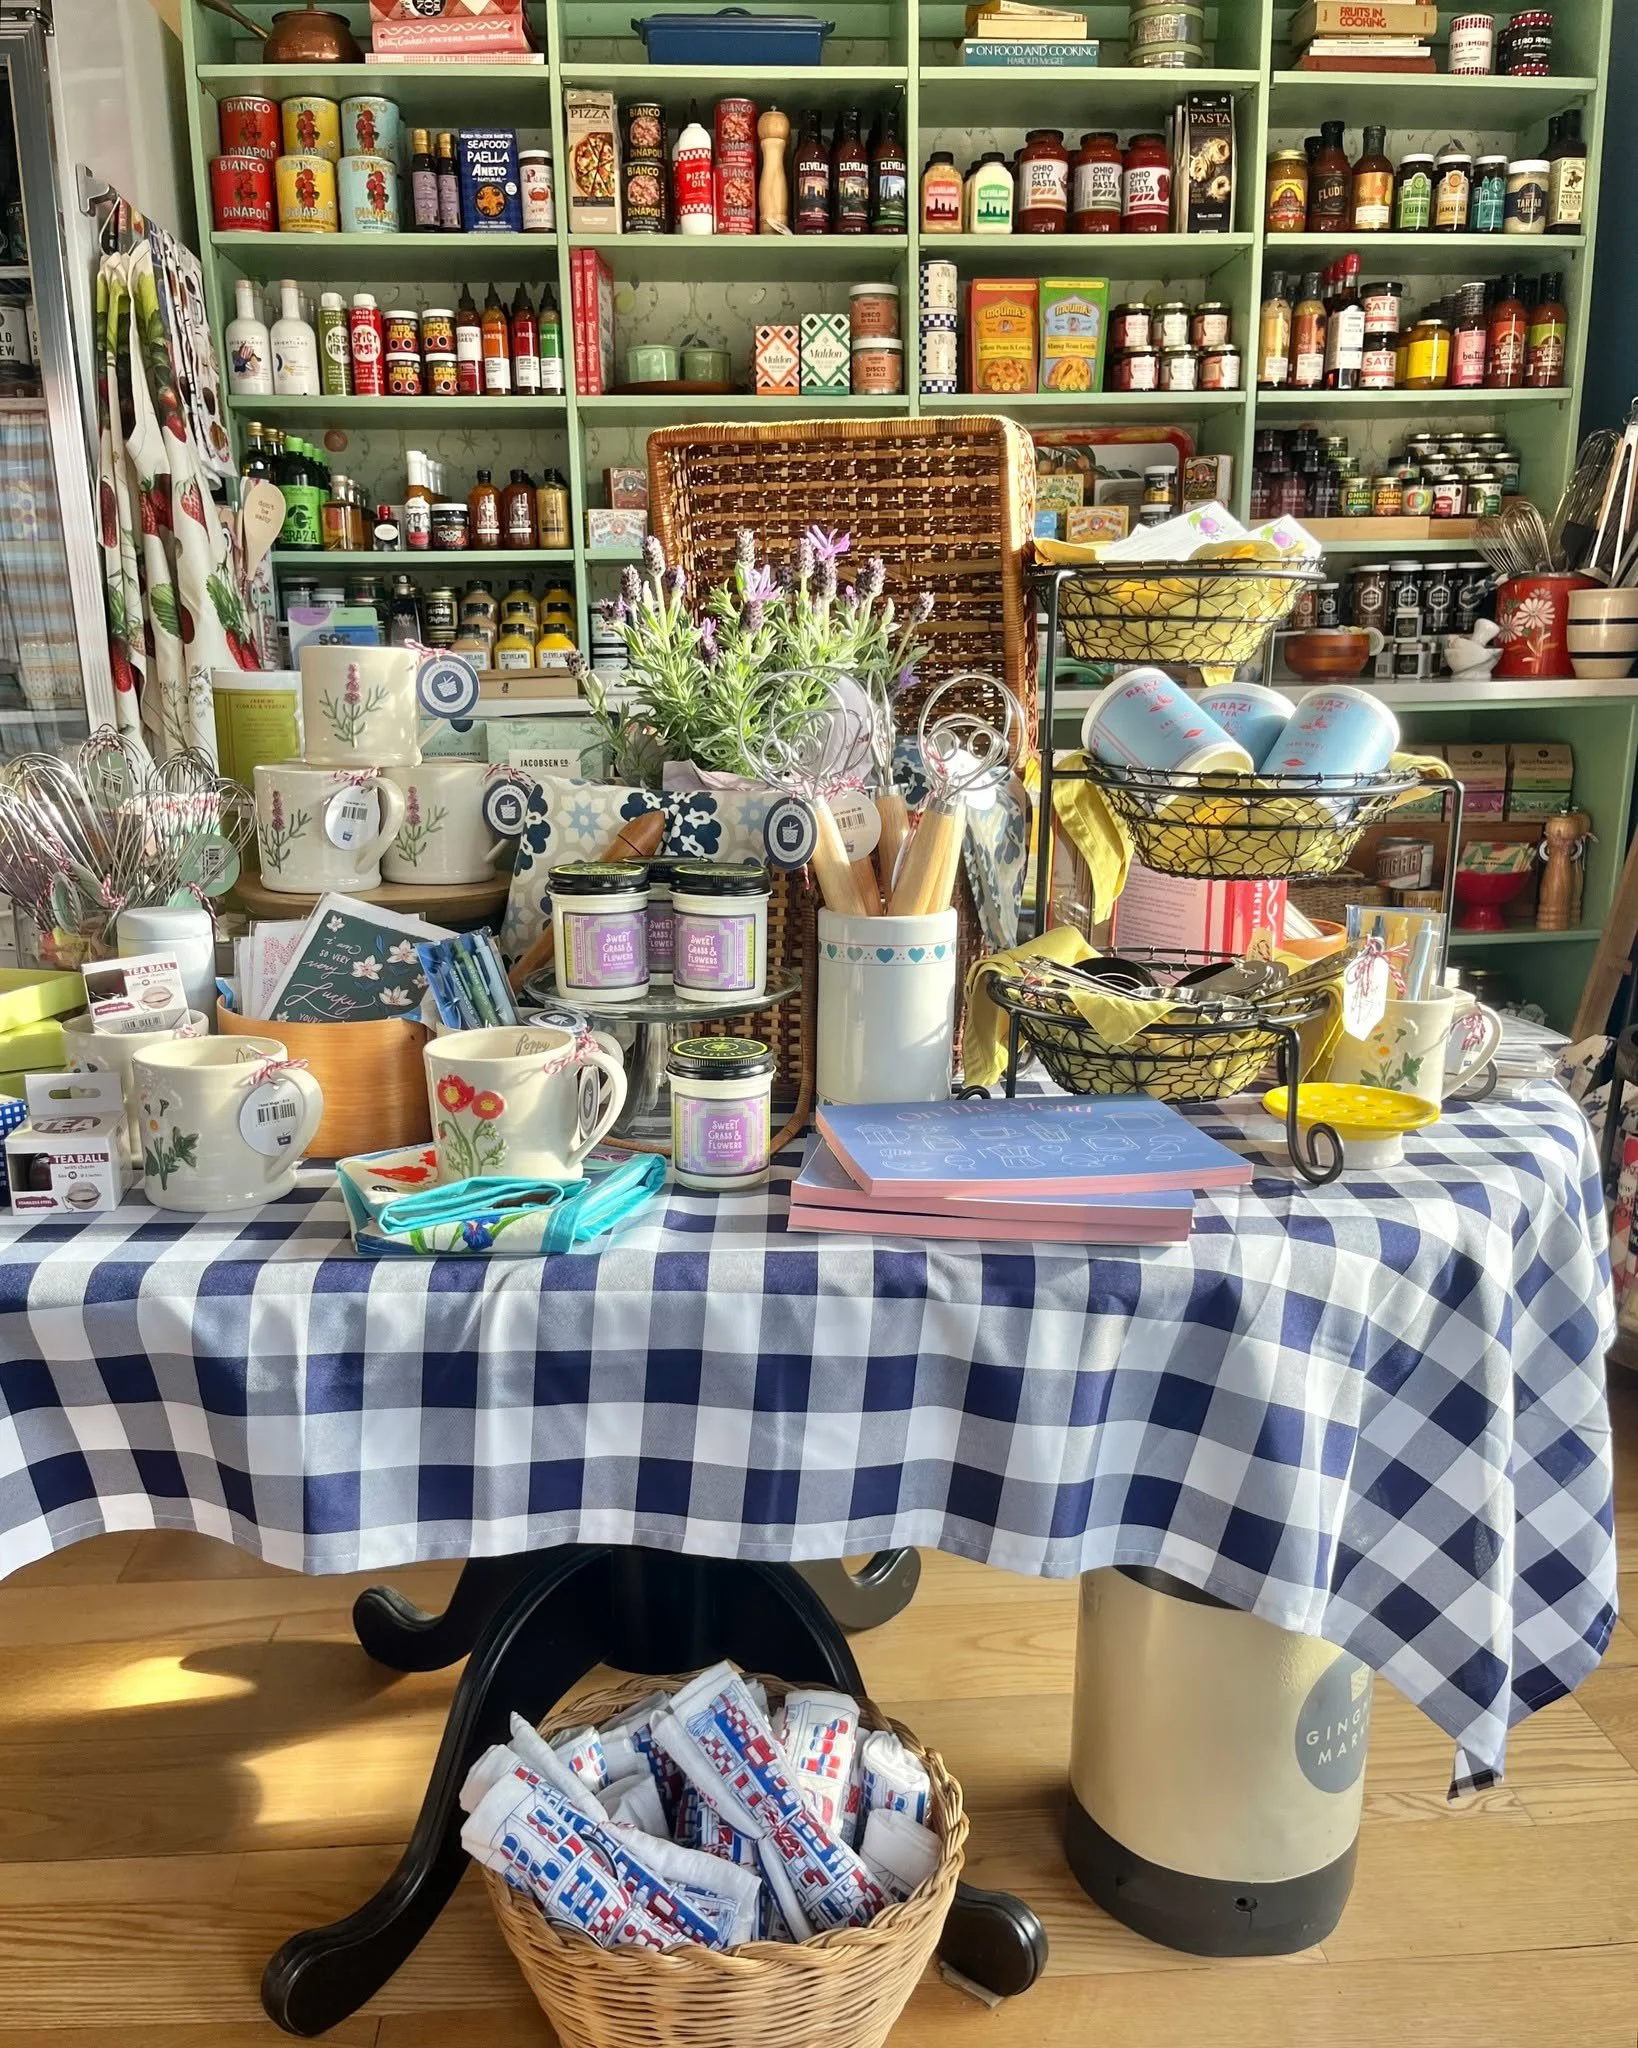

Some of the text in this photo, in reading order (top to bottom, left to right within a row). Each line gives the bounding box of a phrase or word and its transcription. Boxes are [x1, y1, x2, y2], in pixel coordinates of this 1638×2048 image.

[1340, 7, 1383, 18] FRUITS IN
[1340, 18, 1387, 28] COOKING
[976, 45, 1097, 56] ON FOOD AND COOKING
[1007, 57, 1038, 65] HAROLD
[227, 102, 271, 113] BIANCO
[629, 108, 661, 117] BIANCO
[570, 109, 610, 119] PIZZA
[1190, 113, 1231, 124] PASTA
[467, 140, 509, 149] SEAFOOD
[467, 151, 510, 163] PAELLA
[220, 160, 265, 173] BIANCO
[627, 166, 660, 176] BIANCO
[1032, 164, 1054, 172] OHIO
[1093, 167, 1114, 175] OHIO
[686, 172, 711, 180] PIZZA
[1130, 171, 1151, 180] OHIO
[691, 180, 707, 188] OIL
[1093, 181, 1117, 189] PASTA
[1130, 186, 1155, 195] PASTA
[1365, 300, 1395, 311] SATÉ
[809, 348, 843, 359] Maldon
[763, 355, 792, 364] Maldon
[1366, 355, 1394, 366] SATÉ
[284, 530, 318, 544] GRAZA
[520, 759, 559, 767] JACOBSEN
[320, 949, 350, 964] SO VERY
[603, 953, 634, 963] FLOWERS
[688, 954, 718, 965] FLOWERS
[127, 963, 175, 976] TEA BALL
[284, 982, 376, 1019] Lucky
[516, 1032, 551, 1057] Poppy
[896, 1111, 942, 1122] On
[1008, 1101, 1092, 1113] Menu
[37, 1118, 97, 1131] TEA
[708, 1140, 743, 1150] FLOWERS
[53, 1154, 105, 1164] TEA BALL
